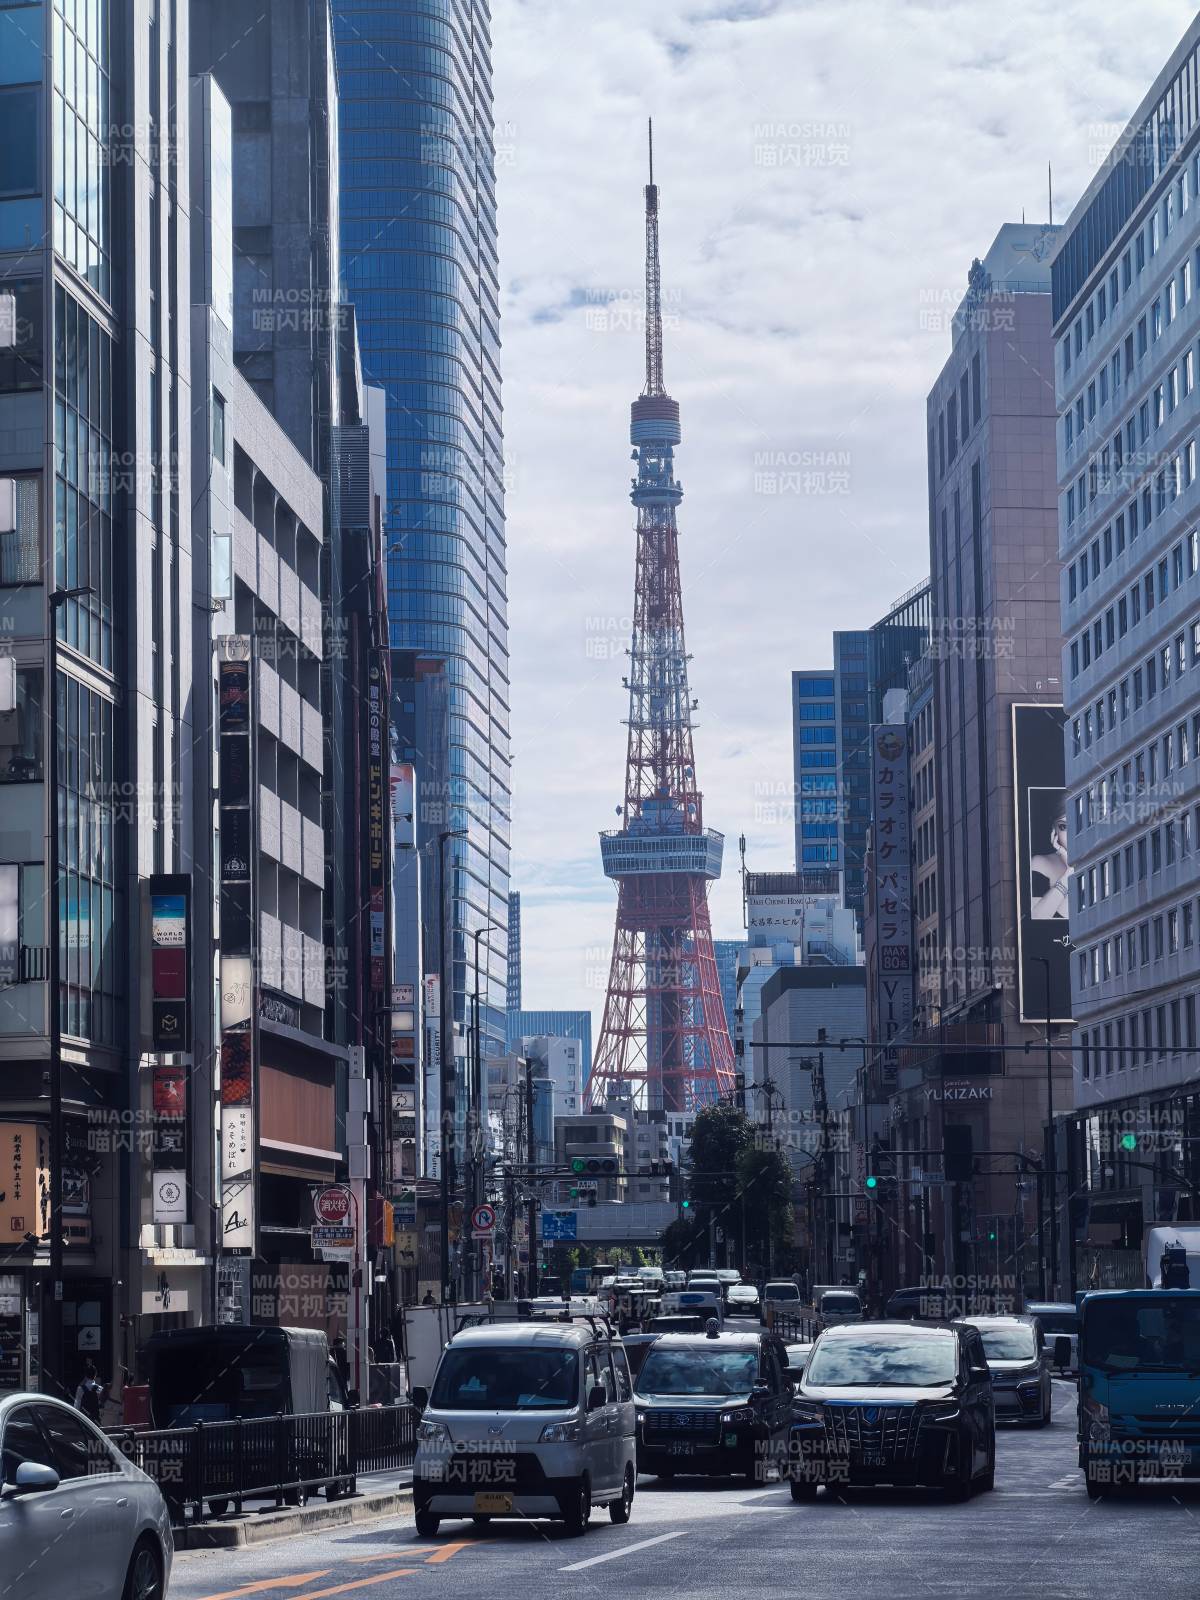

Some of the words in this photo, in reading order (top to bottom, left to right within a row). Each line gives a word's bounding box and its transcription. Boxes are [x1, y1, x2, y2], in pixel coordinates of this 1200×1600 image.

[879, 766, 897, 859] カラオケ
[880, 872, 898, 940] パセラ
[883, 946, 906, 957] MAX
[923, 1087, 993, 1101] YUKIZAKI
[228, 1122, 237, 1169] みそめぼれ
[320, 1199, 348, 1212] 消火栓
[863, 1456, 887, 1466] 17-02
